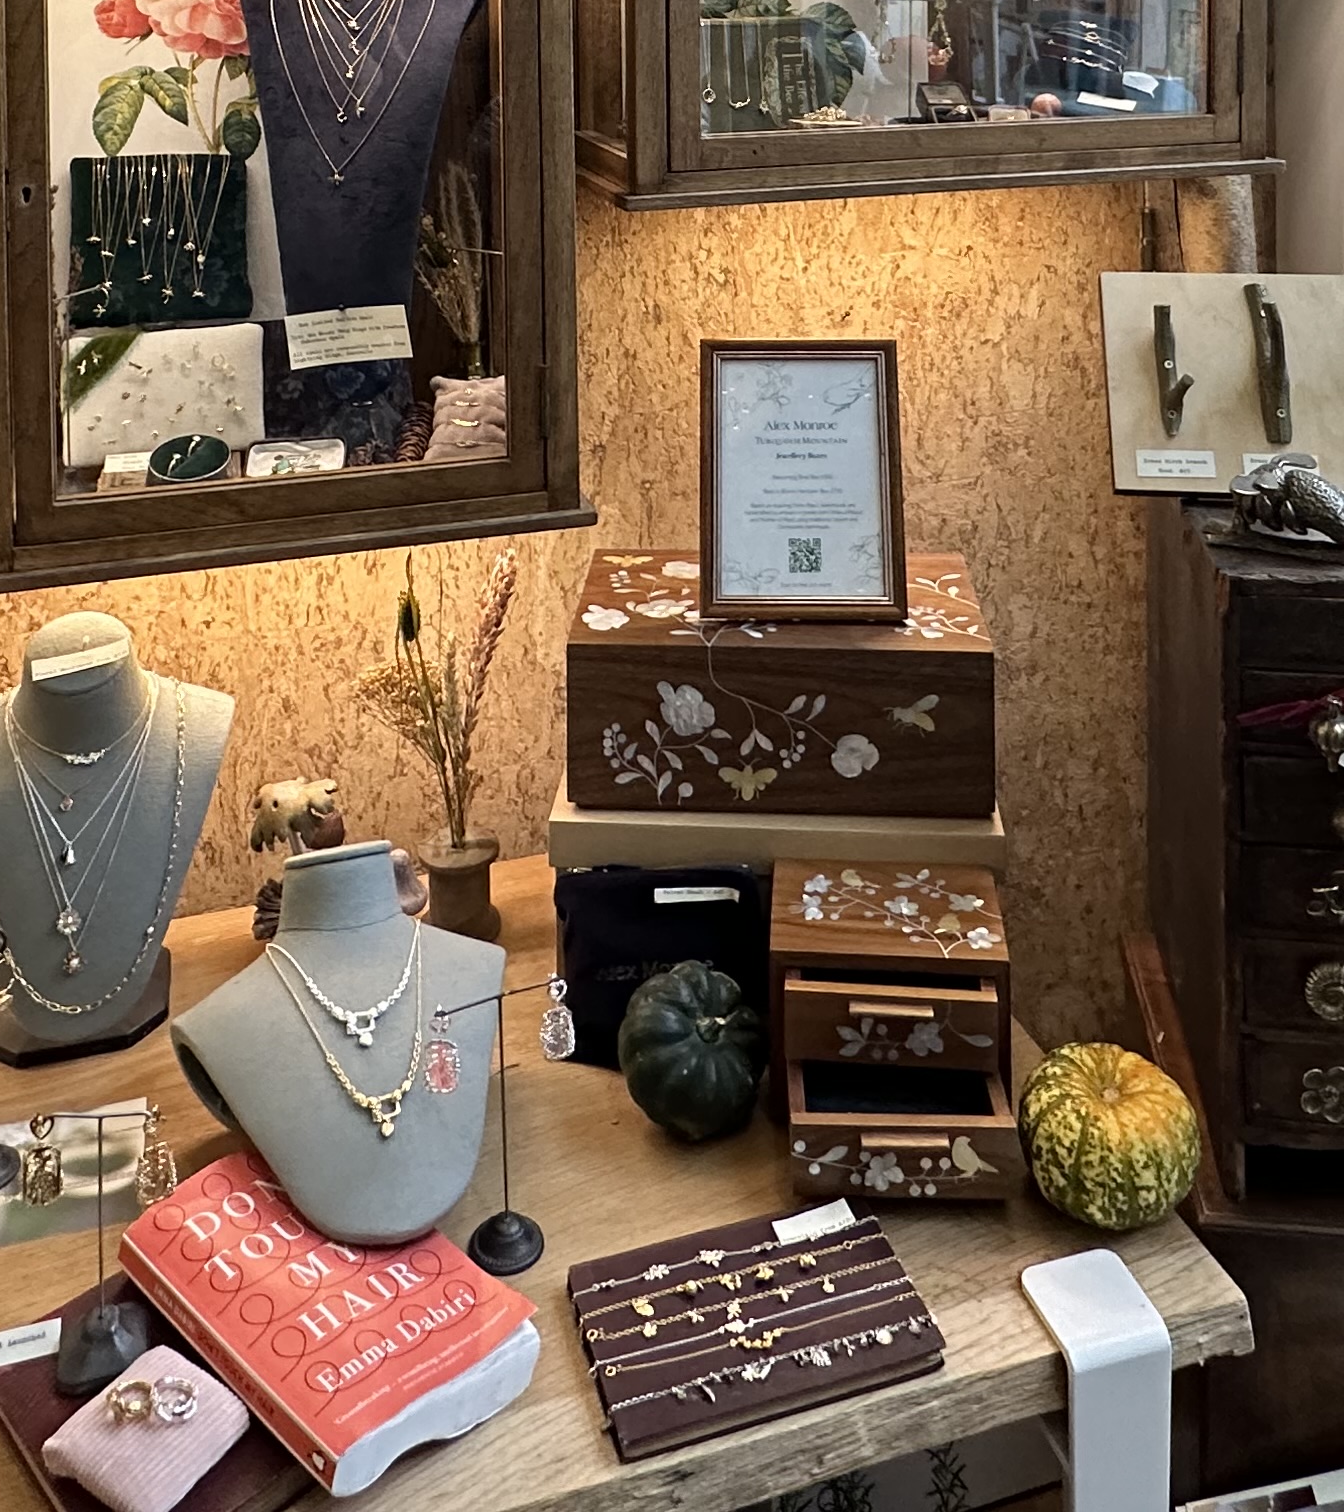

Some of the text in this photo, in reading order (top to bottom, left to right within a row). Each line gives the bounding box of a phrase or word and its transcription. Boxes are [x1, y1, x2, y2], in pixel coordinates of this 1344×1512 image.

[763, 419, 838, 431] Alex Monroe
[285, 1241, 360, 1287] MY
[296, 1261, 425, 1341] HAIR
[315, 1337, 399, 1394] Emma
[394, 1288, 477, 1343] Dabiri
